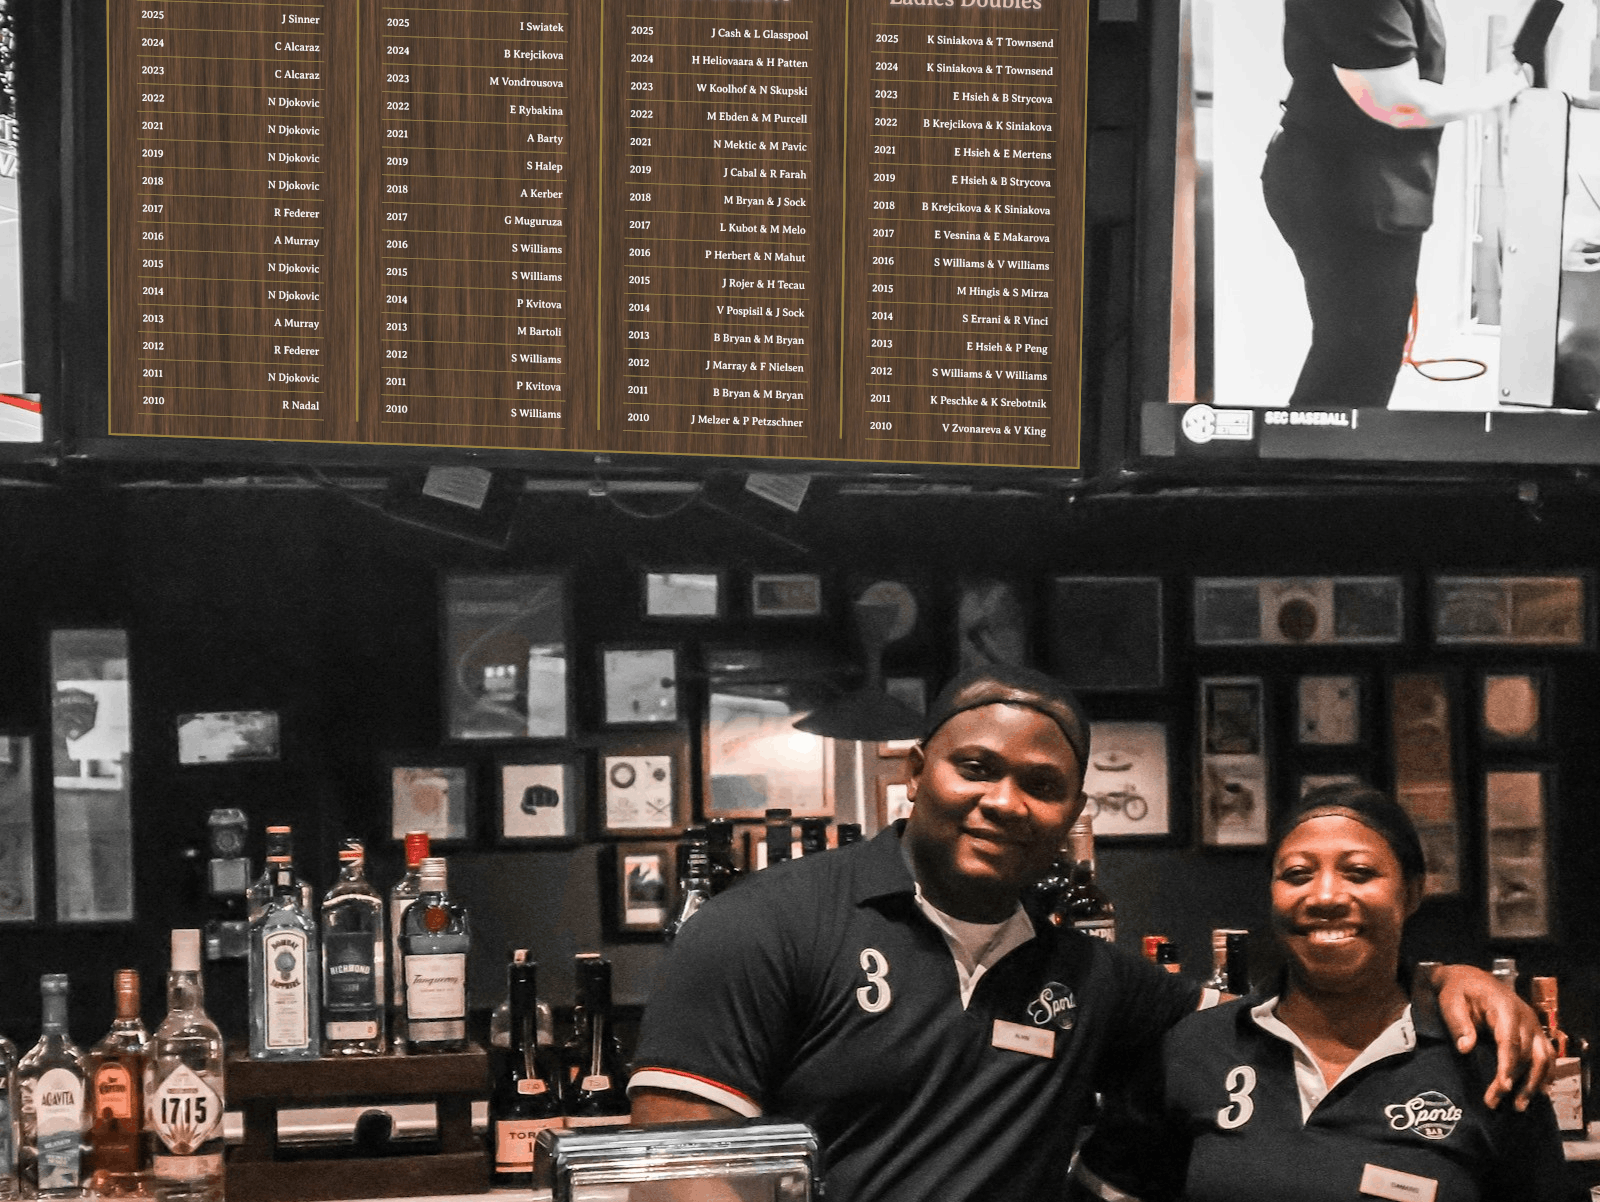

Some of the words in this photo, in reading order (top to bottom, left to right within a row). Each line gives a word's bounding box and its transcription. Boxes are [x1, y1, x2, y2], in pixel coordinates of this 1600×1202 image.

[141, 9, 165, 20] 2025
[281, 13, 287, 25] J
[288, 13, 321, 25] Sinner
[386, 17, 410, 28] 2025
[519, 21, 525, 31] I
[526, 21, 564, 33] Swiatek
[630, 25, 654, 36] 2025
[710, 27, 716, 39] J
[717, 27, 742, 38] Cash
[743, 29, 752, 39] &
[753, 28, 761, 39] L
[762, 29, 809, 42] Glasspool
[141, 65, 165, 76] 2023
[274, 69, 282, 79] C
[283, 69, 321, 80] Alcaraz
[875, 61, 899, 72] 2024
[926, 62, 935, 73] K
[936, 62, 984, 74] Siniakova
[985, 64, 994, 74] &
[995, 64, 1004, 75] T
[1004, 65, 1054, 76] Townsend
[386, 73, 410, 84] 2023
[489, 76, 500, 86] M
[501, 76, 564, 88] Vondrousova
[630, 81, 654, 92] 2023
[696, 83, 708, 93] W
[709, 83, 748, 94] Koolhof
[748, 85, 757, 95] &
[759, 85, 768, 95] N
[769, 85, 808, 98] Skupski
[141, 120, 164, 131] 2021
[267, 124, 277, 134] N
[278, 124, 320, 137] Djokovic
[874, 117, 898, 127] 2022
[922, 118, 931, 128] B
[932, 118, 984, 131] Krejcikova
[985, 120, 994, 130] &
[995, 120, 1004, 131] K
[1005, 120, 1053, 132] Siniakova
[386, 129, 409, 139] 2021
[526, 133, 535, 143] A
[536, 133, 564, 146] Barty
[629, 137, 652, 147] 2021
[713, 139, 722, 149] N
[723, 139, 757, 150] Mektic
[758, 140, 767, 151] &
[769, 141, 779, 151] M
[781, 141, 808, 152] Pavic
[141, 176, 164, 186] 2018
[267, 180, 277, 190] N
[278, 180, 320, 192] Djokovic
[873, 172, 896, 183] 2019
[951, 174, 959, 185] E
[960, 175, 989, 186] Hsieh
[989, 176, 998, 186] &
[1000, 176, 1008, 186] B
[1009, 176, 1052, 189] Strycova
[386, 184, 409, 194] 2018
[519, 188, 529, 198] A
[530, 188, 564, 199] Kerber
[629, 192, 652, 202] 2018
[723, 195, 734, 205] M
[735, 195, 765, 208] Bryan
[766, 196, 775, 206] &
[776, 196, 782, 208] J
[783, 196, 807, 207] Sock
[142, 231, 165, 241] 2016
[273, 235, 283, 245] A
[283, 235, 320, 249] Murray
[872, 228, 895, 238] 2017
[934, 229, 942, 240] E
[942, 230, 982, 241] Vesnina
[983, 231, 991, 241] &
[993, 231, 1001, 242] E
[1002, 232, 1051, 243] Makarova
[386, 239, 409, 249] 2016
[511, 243, 519, 253] S
[519, 243, 563, 255] Williams
[628, 247, 651, 257] 2016
[704, 249, 712, 259] P
[713, 250, 752, 261] Herbert
[753, 251, 762, 261] &
[763, 251, 773, 262] N
[774, 252, 806, 263] Mahut
[142, 286, 164, 296] 2014
[267, 290, 277, 300] N
[278, 290, 320, 302] Djokovic
[871, 283, 894, 294] 2015
[956, 286, 967, 296] M
[968, 286, 1001, 299] Hingis
[1002, 287, 1010, 297] &
[1012, 287, 1019, 298] S
[1020, 288, 1049, 299] Mirza
[386, 294, 408, 305] 2014
[516, 298, 524, 308] P
[525, 298, 562, 310] Kvitova
[628, 302, 651, 313] 2014
[716, 305, 725, 315] V
[726, 305, 764, 318] Pospisil
[765, 307, 773, 317] &
[774, 307, 781, 318] J
[782, 307, 805, 318] Sock
[142, 341, 165, 351] 2012
[273, 345, 282, 355] R
[283, 345, 320, 356] Federer
[871, 338, 893, 349] 2013
[966, 341, 974, 351] E
[975, 341, 1003, 352] Hsieh
[1004, 343, 1013, 353] &
[1015, 342, 1023, 353] P
[1024, 343, 1049, 356] Peng
[385, 349, 408, 359] 2012
[510, 353, 518, 363] S
[519, 353, 562, 365] Williams
[627, 357, 650, 368] 2012
[705, 360, 711, 371] J
[712, 360, 748, 373] Marray
[749, 361, 758, 371] &
[759, 361, 767, 371] F
[768, 362, 805, 373] Nielsen
[142, 395, 165, 405] 2010
[282, 400, 290, 410] R
[291, 400, 320, 411] Nadal
[870, 393, 891, 403] 2011
[930, 395, 938, 405] K
[939, 395, 979, 406] Peschke
[980, 397, 988, 407] &
[990, 397, 999, 407] K
[1000, 397, 1047, 409] Srebotnik
[385, 404, 408, 414] 2010
[510, 407, 518, 418] S
[518, 408, 562, 419] Williams
[1289, 411, 1349, 427] BASEBALL
[329, 963, 371, 976] RICHMOND
[856, 947, 892, 1013] 3
[1217, 1065, 1257, 1130] 3
[160, 1096, 207, 1125] 1715
[1384, 1097, 1463, 1131] Sports
[508, 1131, 537, 1140] TOR
